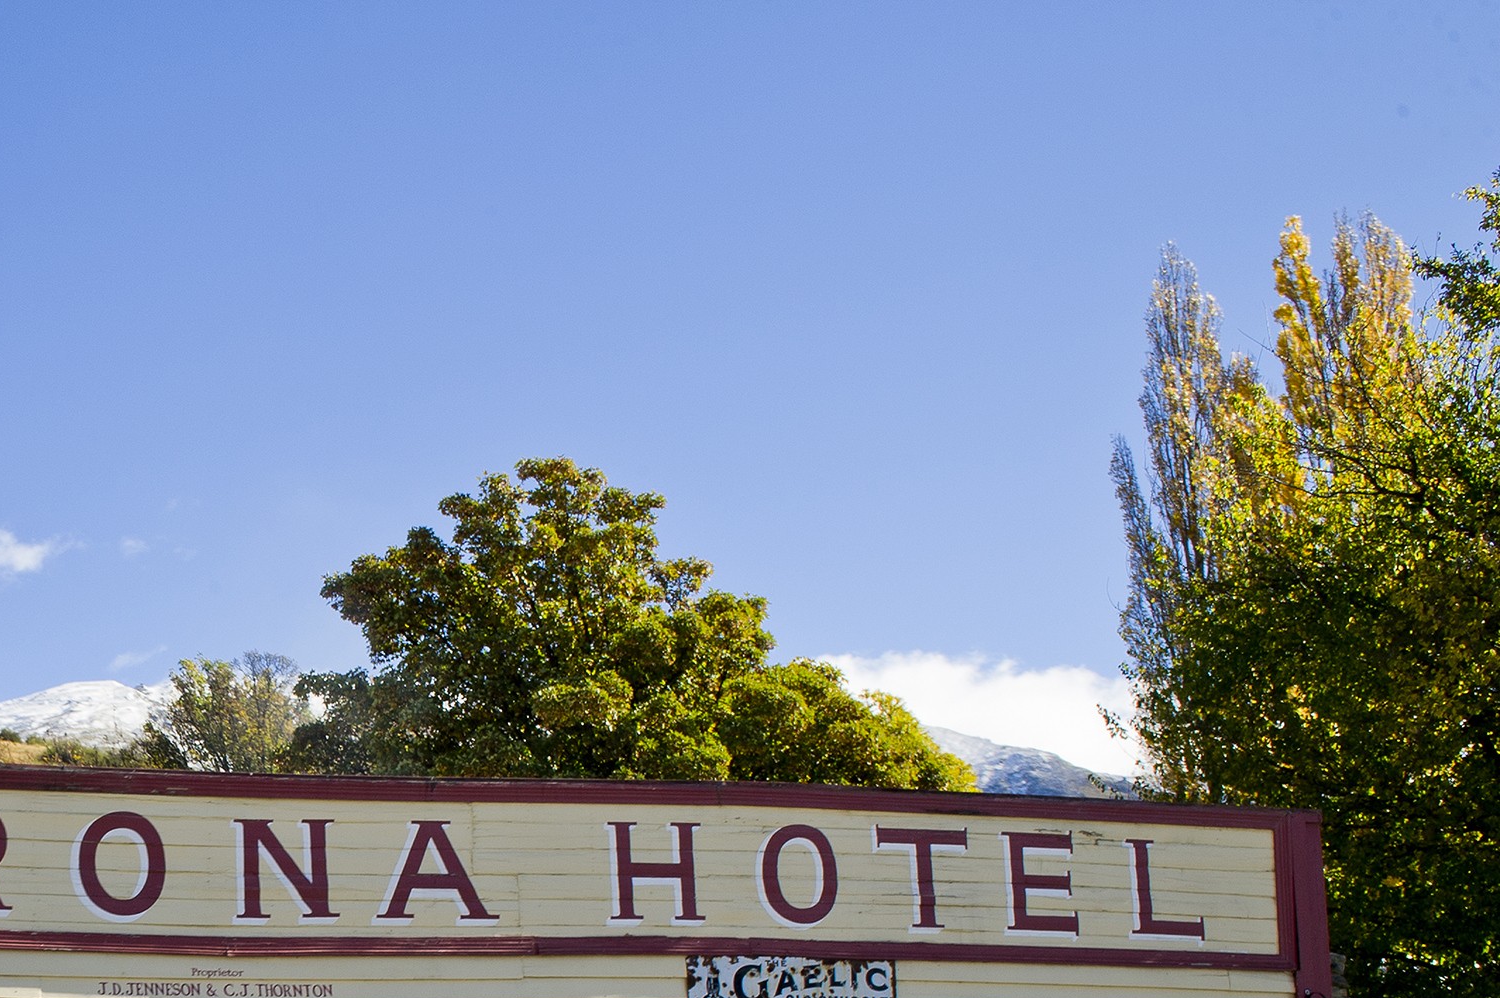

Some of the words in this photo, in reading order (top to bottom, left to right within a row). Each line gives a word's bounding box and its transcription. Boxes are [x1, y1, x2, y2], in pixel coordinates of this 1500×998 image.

[604, 821, 1205, 946] HOTEL
[765, 959, 787, 967] THE
[191, 967, 244, 978] Proprietor
[206, 983, 219, 997] &
